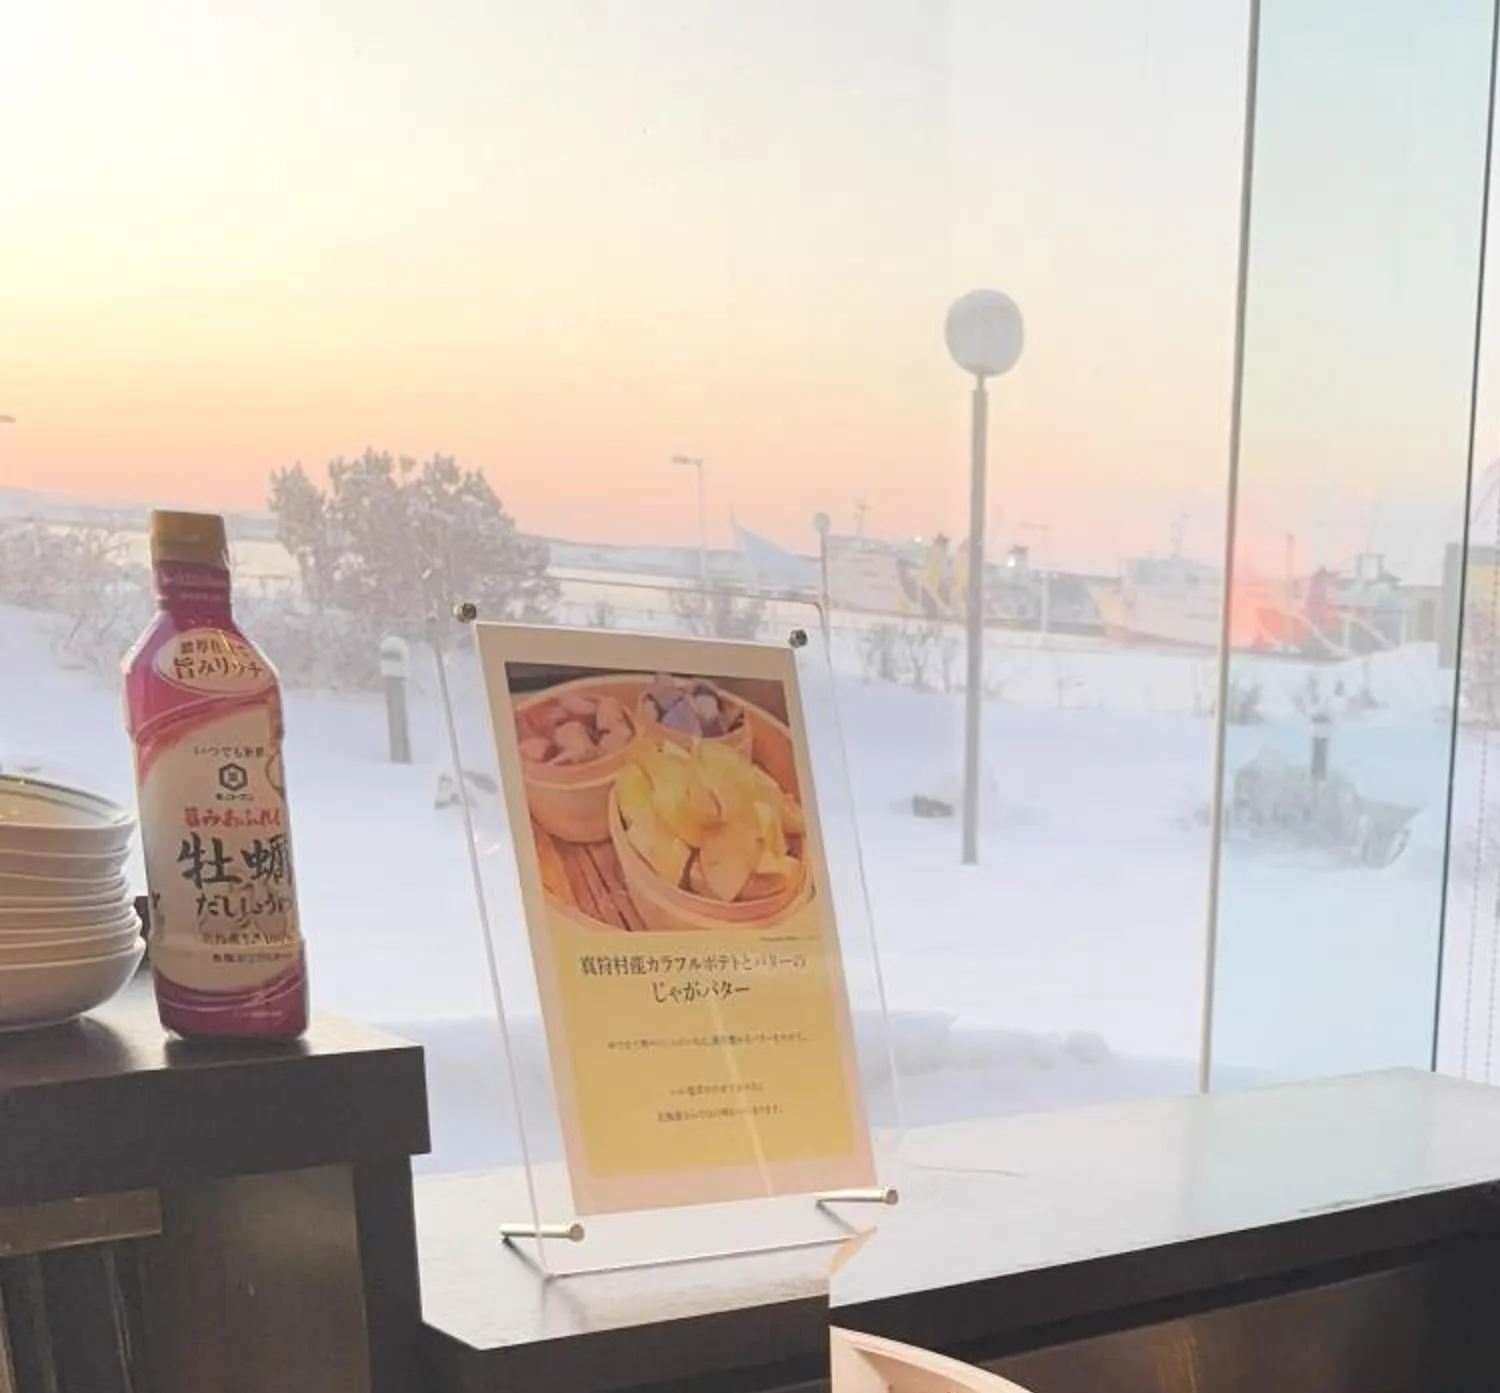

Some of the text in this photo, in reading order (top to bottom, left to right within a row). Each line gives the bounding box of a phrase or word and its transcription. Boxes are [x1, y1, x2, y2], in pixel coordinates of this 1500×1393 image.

[652, 979, 751, 1004] じゃがバター
